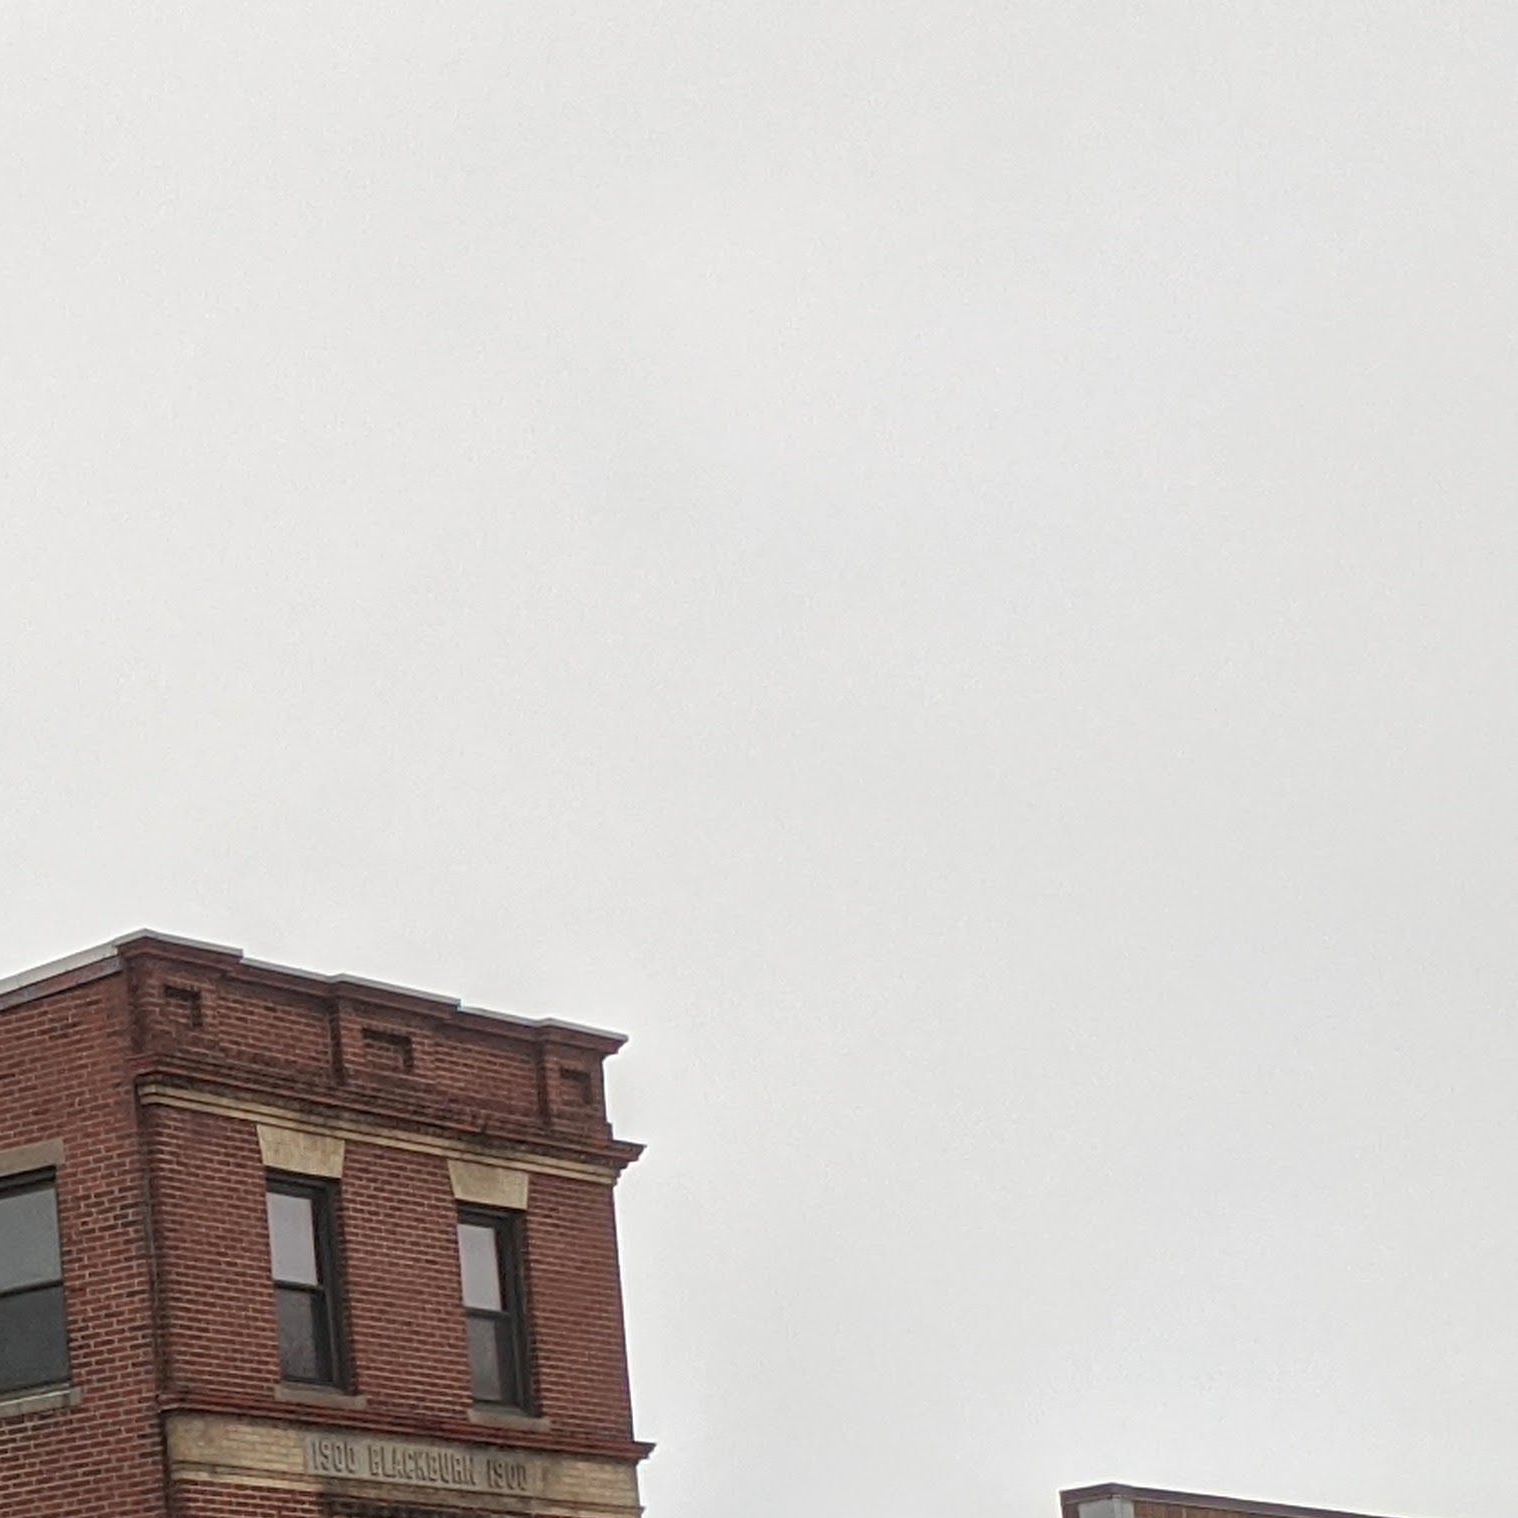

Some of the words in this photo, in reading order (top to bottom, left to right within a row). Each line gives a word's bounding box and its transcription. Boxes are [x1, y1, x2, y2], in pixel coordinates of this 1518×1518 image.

[310, 1440, 355, 1474] 1900
[367, 1444, 476, 1486] BLACKBURN
[486, 1458, 528, 1491] 1900
